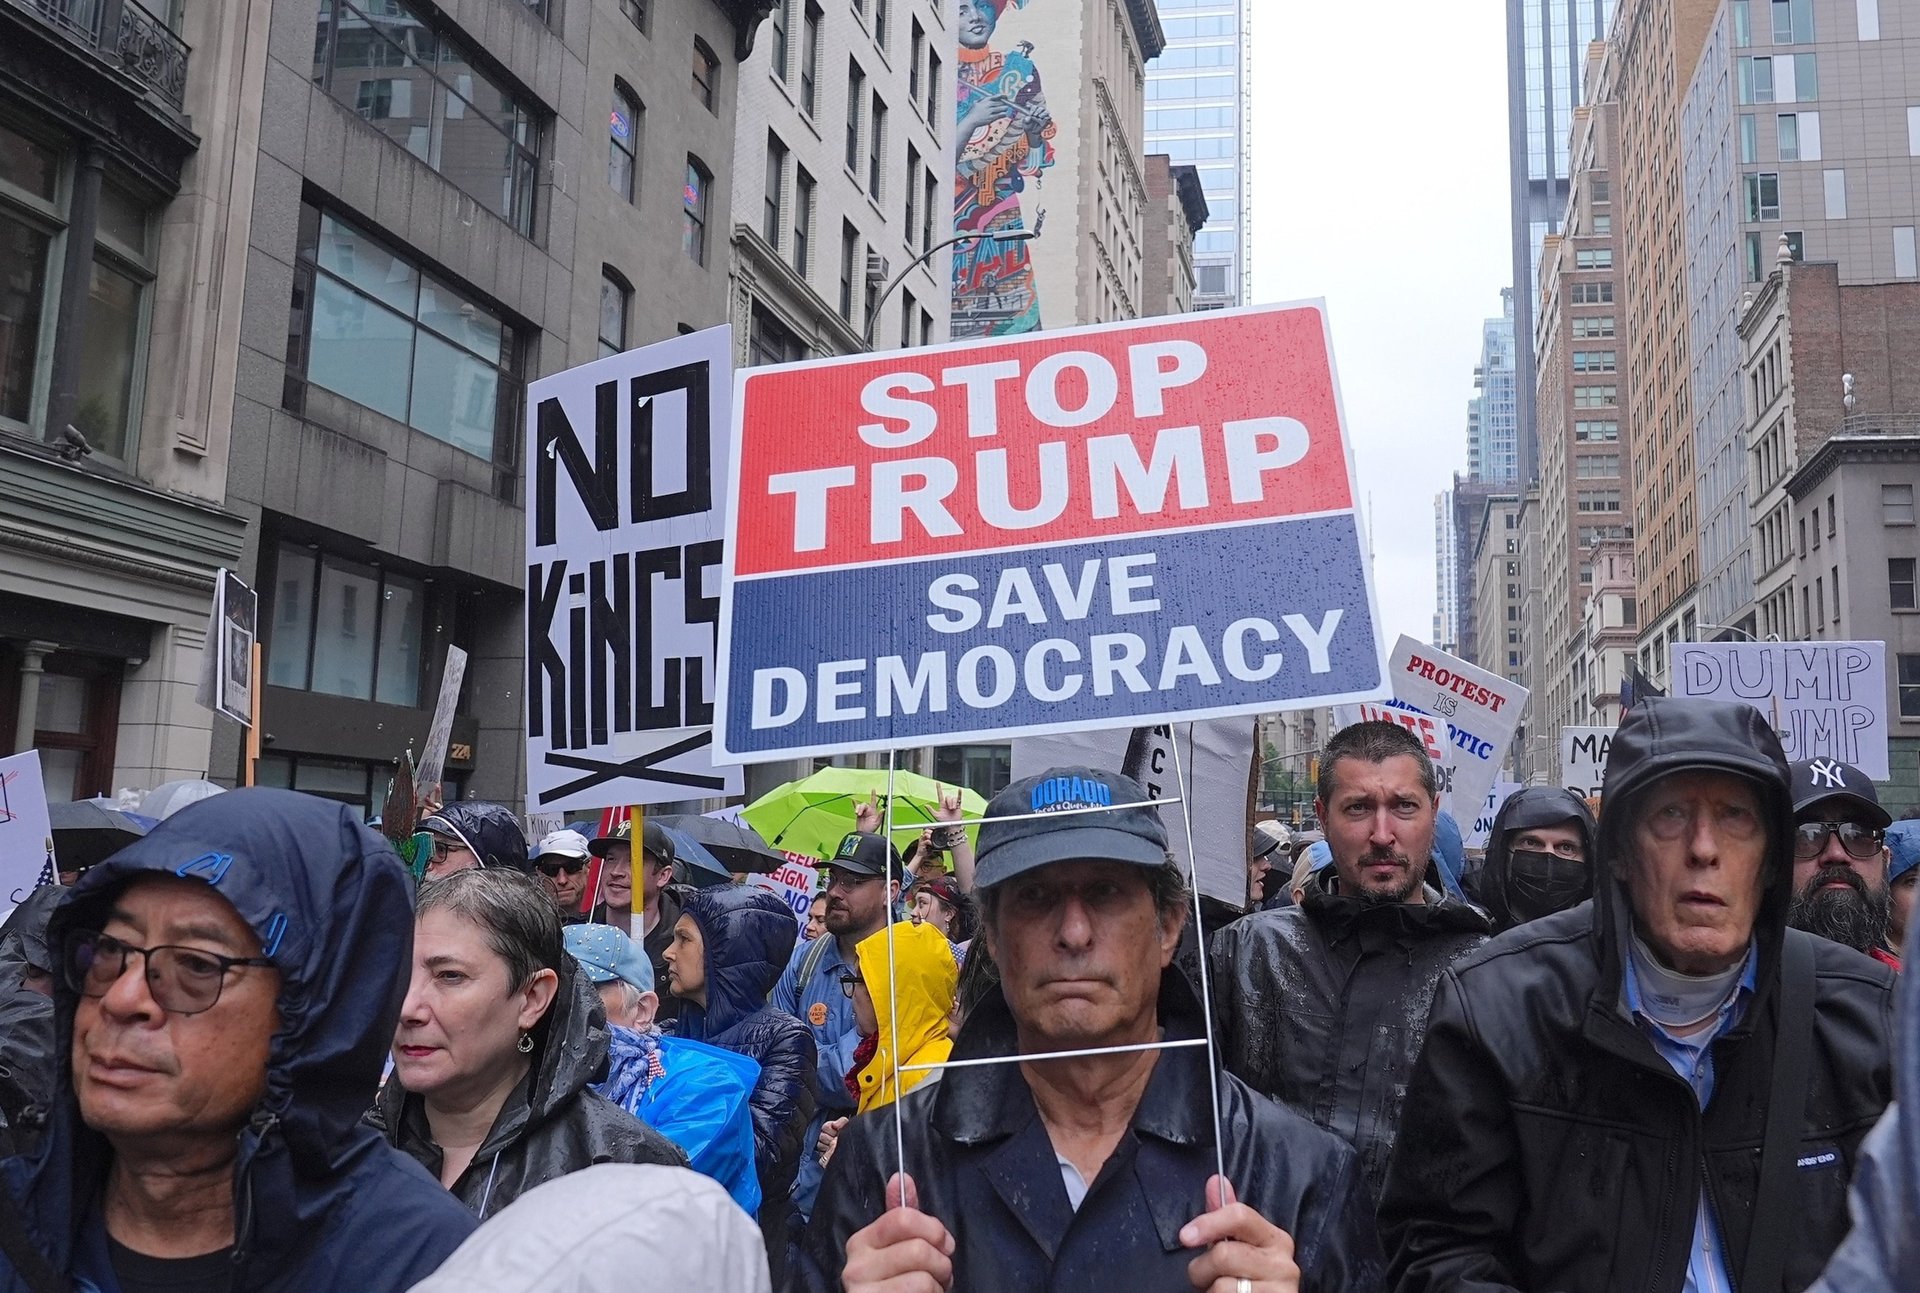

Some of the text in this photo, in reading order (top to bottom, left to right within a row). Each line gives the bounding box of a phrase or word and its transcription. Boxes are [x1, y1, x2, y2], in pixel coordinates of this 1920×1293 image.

[857, 339, 1208, 449] STOP
[535, 359, 712, 546] NO
[767, 416, 1311, 553] TRUMP
[926, 552, 1161, 634] SAVE
[751, 608, 1344, 730] DEMOCRACY
[1406, 654, 1506, 713] PROTEST
[1684, 647, 1872, 702] DUMP
[1432, 692, 1458, 717] IS
[1767, 704, 1875, 765] UMP
[1571, 733, 1611, 764] MA
[1809, 759, 1847, 788] NY
